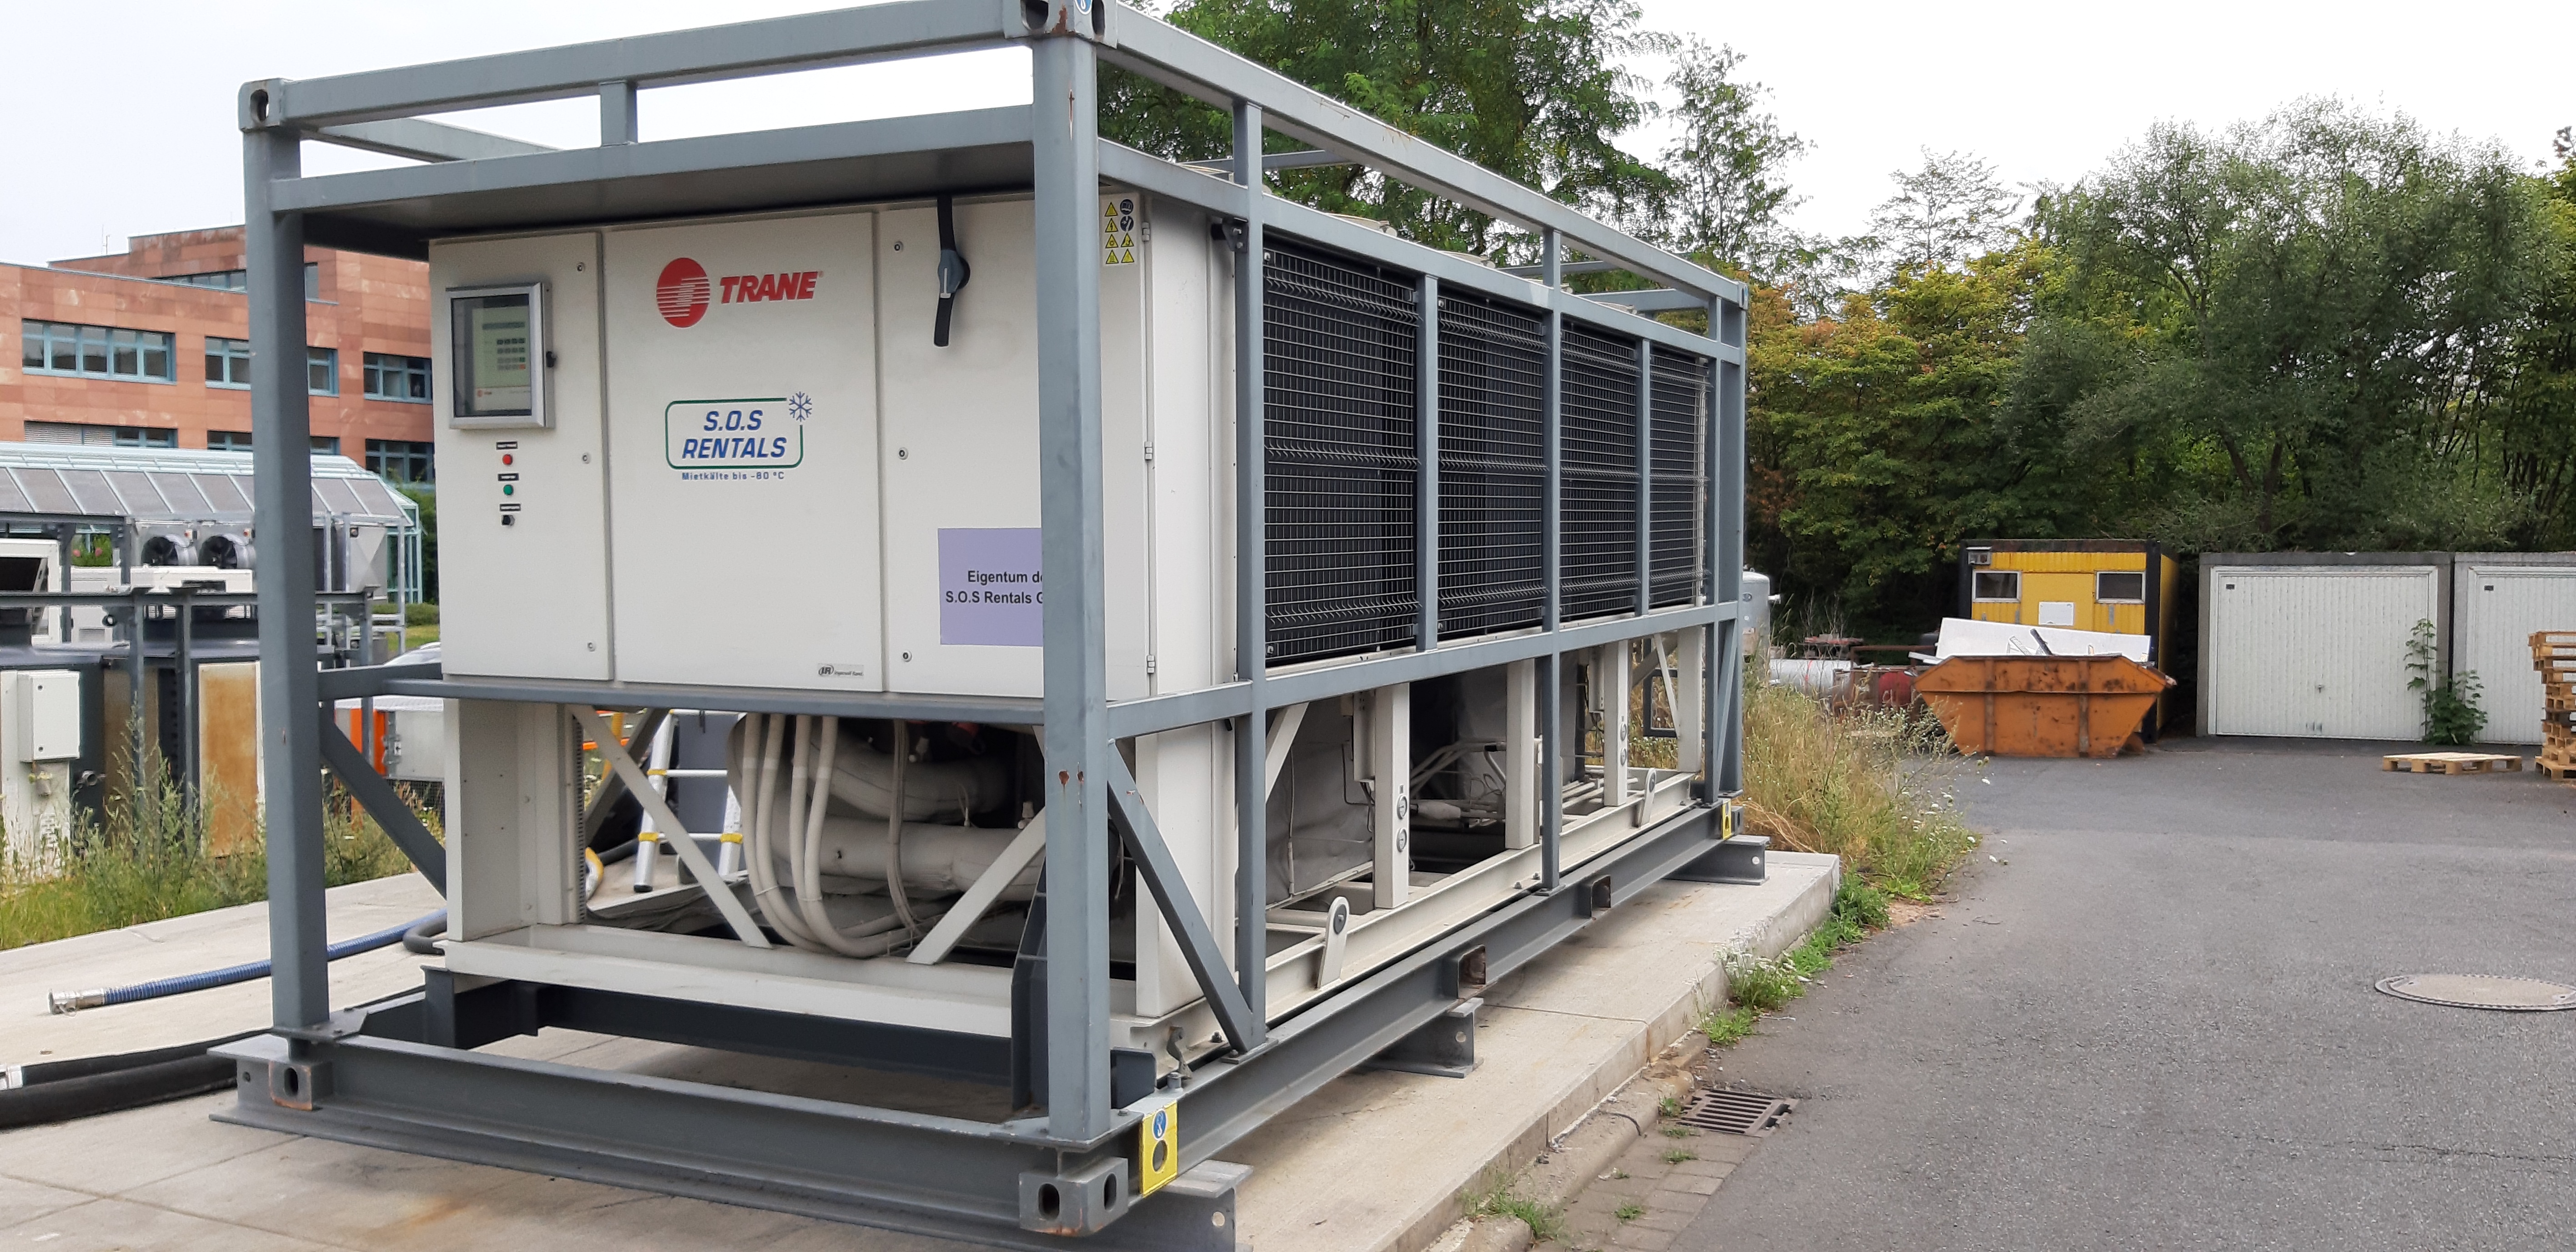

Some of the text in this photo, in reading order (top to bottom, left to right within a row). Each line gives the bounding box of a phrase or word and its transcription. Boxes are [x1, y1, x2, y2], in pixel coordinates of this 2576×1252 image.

[720, 271, 818, 304] TRANE
[704, 410, 763, 431] S.O.S
[682, 437, 787, 459] RENTALS
[733, 472, 747, 480] bis
[968, 570, 1027, 586] Eigentum
[946, 591, 980, 603] S.O.S
[985, 591, 1032, 604] Rentals
